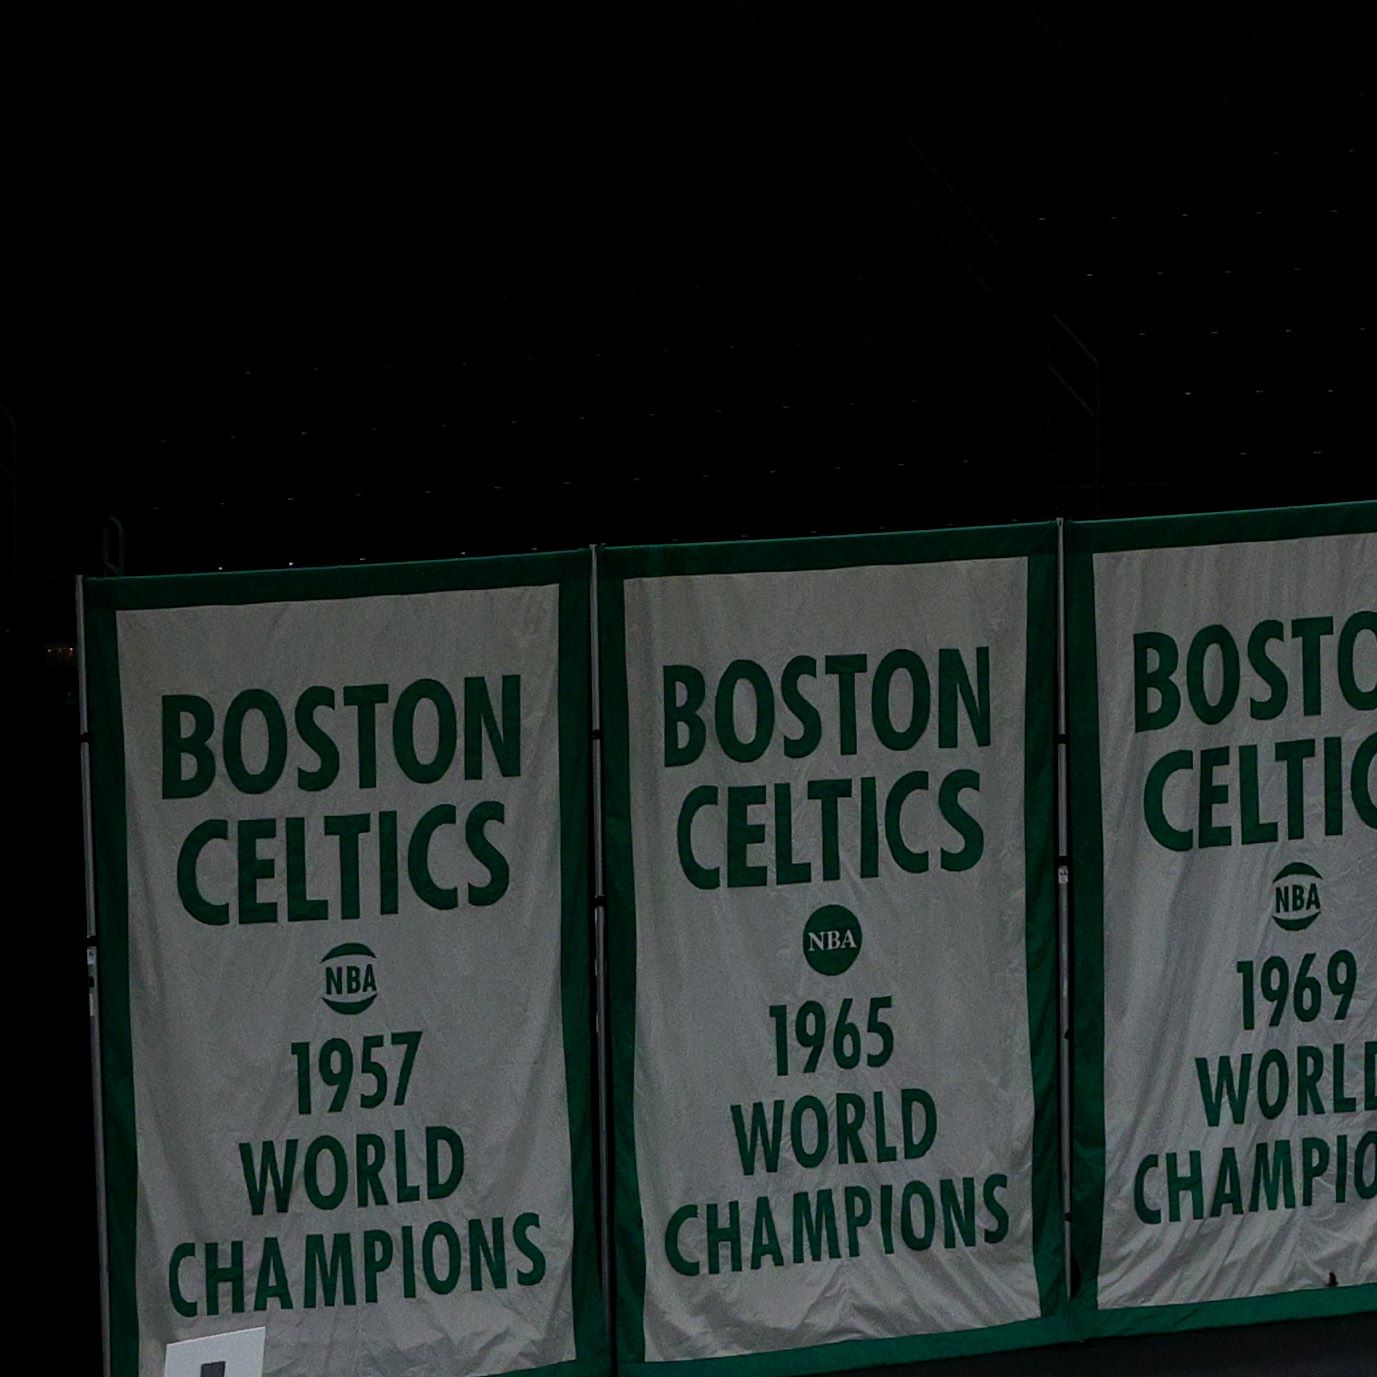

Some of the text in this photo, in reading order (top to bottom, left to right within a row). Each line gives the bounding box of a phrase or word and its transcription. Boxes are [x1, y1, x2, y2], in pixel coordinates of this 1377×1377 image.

[161, 674, 521, 800] BOSTON
[663, 646, 991, 767] BOSTON
[177, 800, 509, 926] CELTICS
[677, 768, 984, 890] CELTICS
[808, 926, 857, 952] NBA
[1275, 884, 1320, 912] NBA
[325, 965, 377, 994] NBA
[1237, 949, 1357, 1030] 1969
[291, 1031, 423, 1115] 1957
[769, 996, 894, 1076] 1965
[239, 1126, 465, 1215] WORLD
[730, 1088, 937, 1176] WORLD
[169, 1212, 547, 1318] CHAMPIONS
[664, 1173, 1009, 1277] CHAMPIONS
